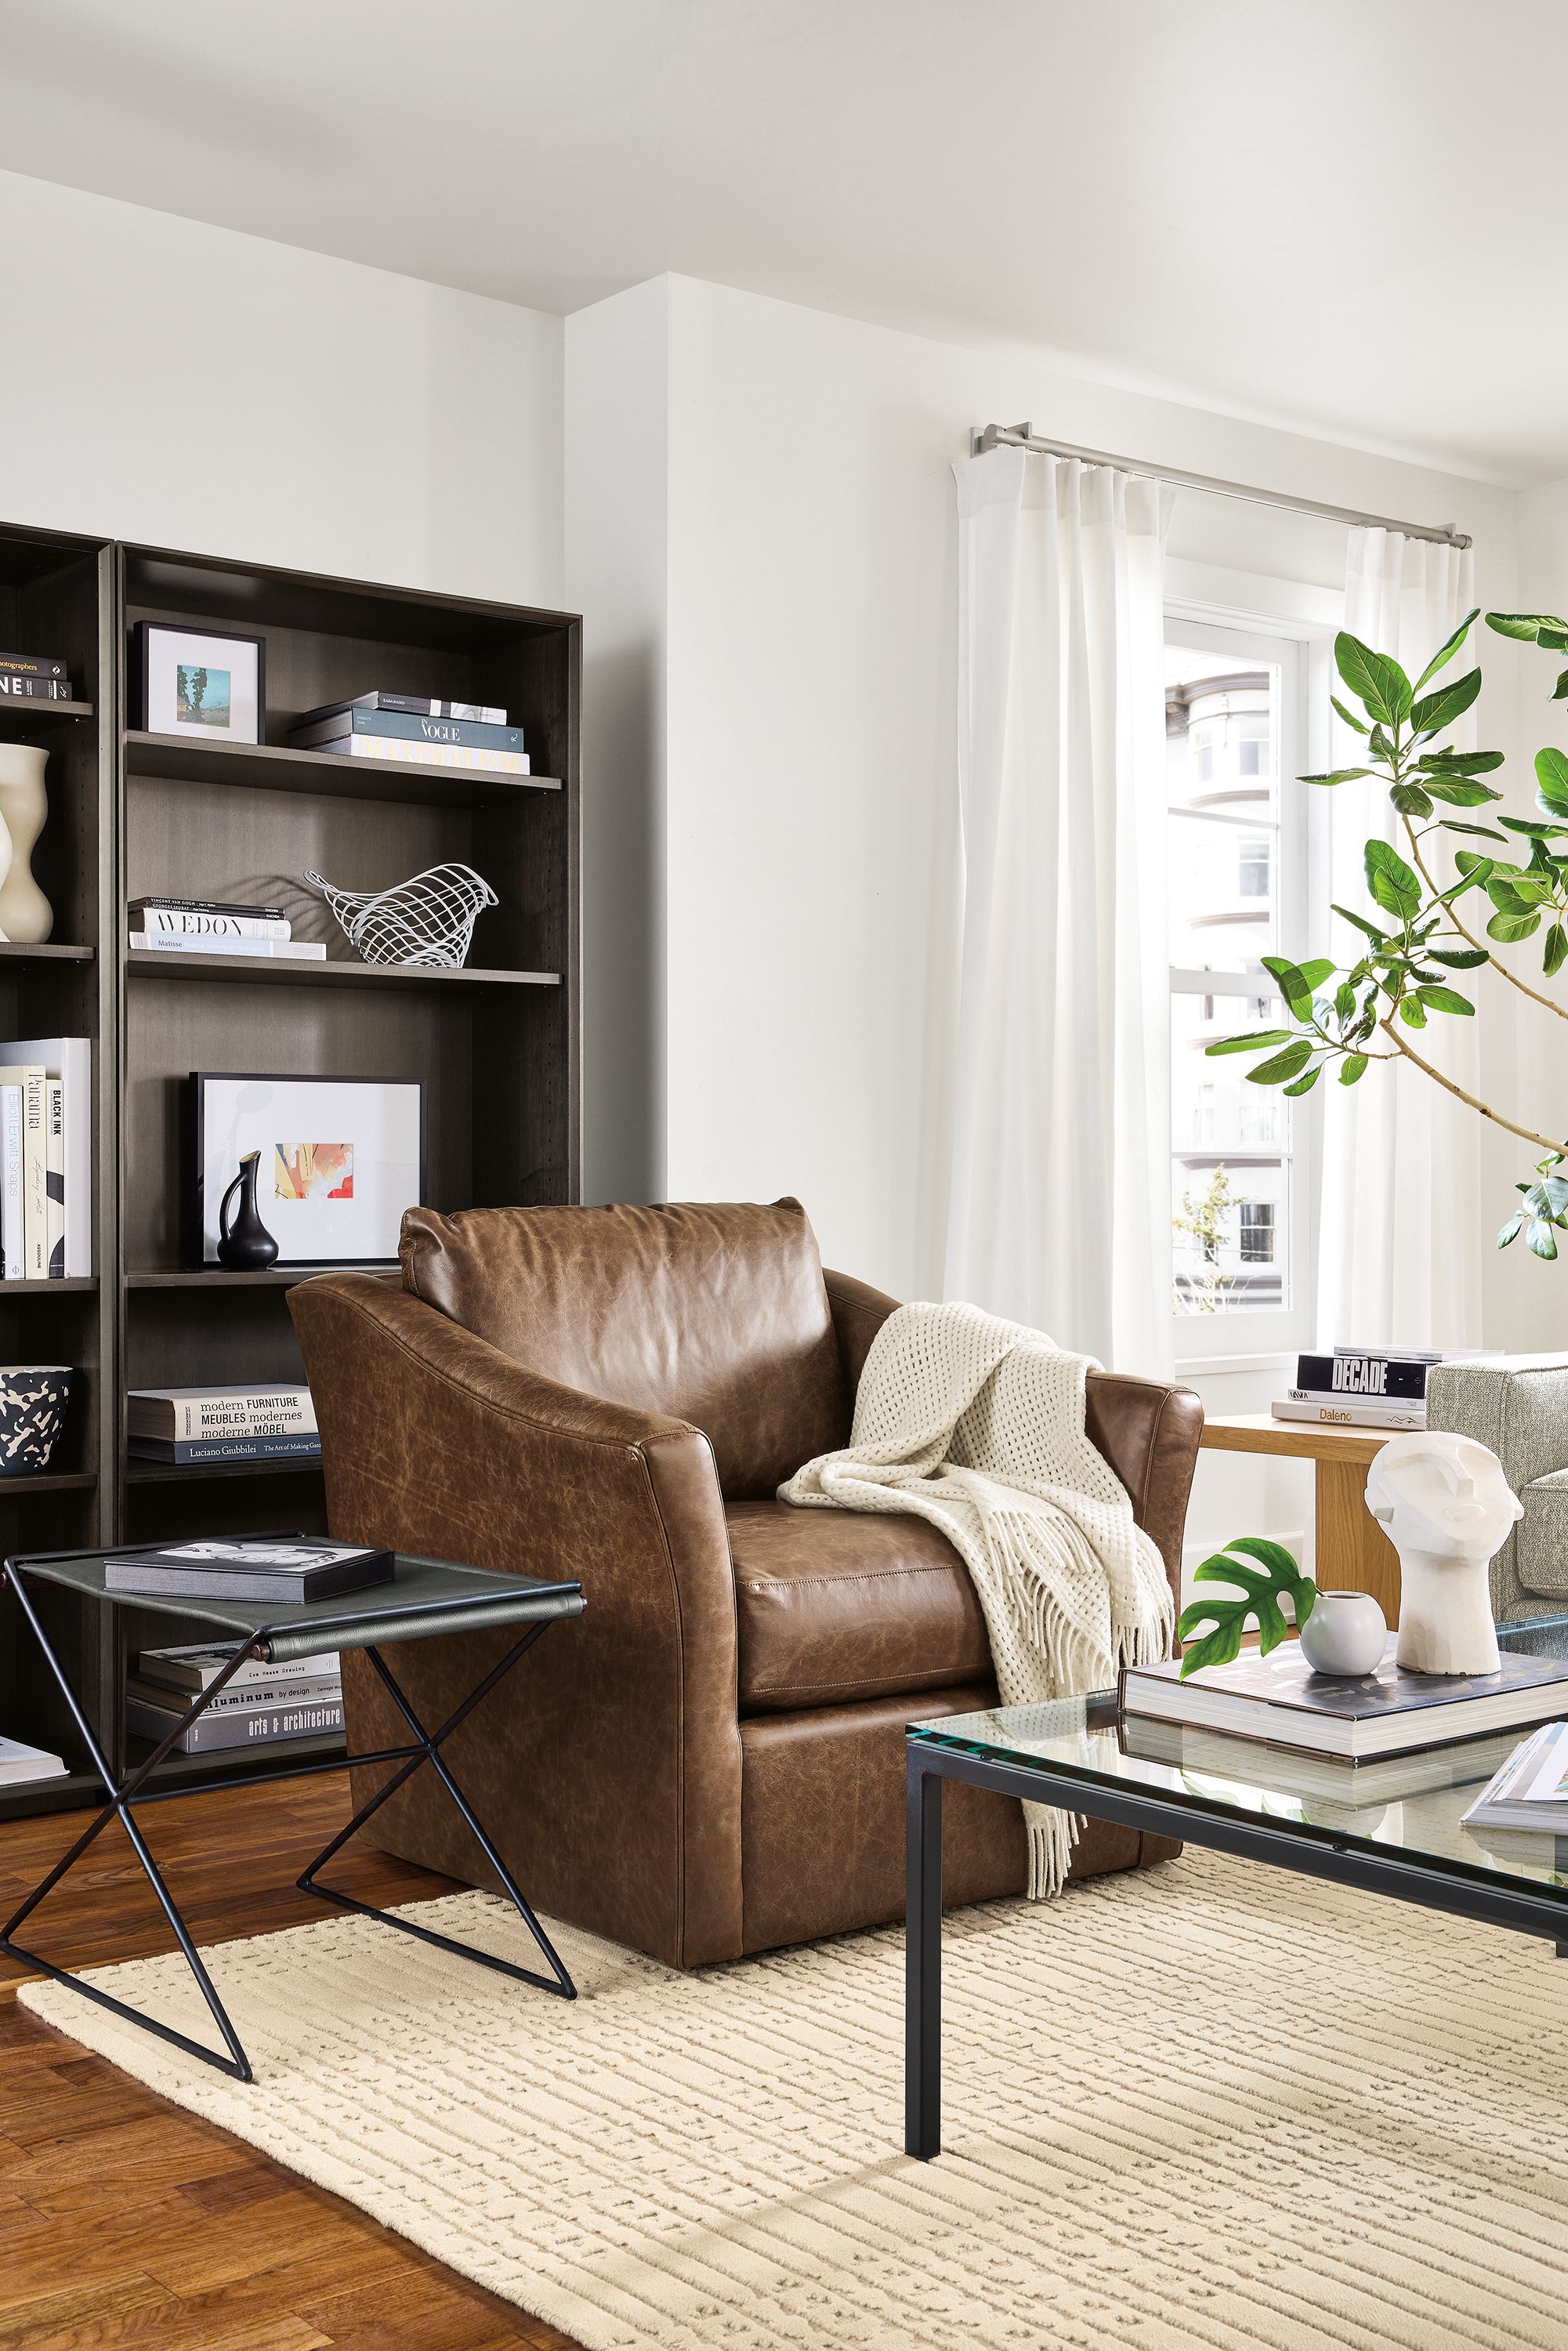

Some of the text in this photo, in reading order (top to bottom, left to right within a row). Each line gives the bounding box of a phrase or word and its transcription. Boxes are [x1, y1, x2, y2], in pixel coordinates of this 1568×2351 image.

[421, 724, 461, 741] VOGUE
[363, 736, 519, 773] MAXIMALISM
[28, 1074, 45, 1130] Panama
[53, 1089, 62, 1136] BLACK INK
[8, 1093, 20, 1197] Elliott Erwitt Snaps
[1331, 1358, 1389, 1394] DECADE
[201, 1396, 299, 1412] modern FURNITURE
[201, 1412, 246, 1425] MEUBLES
[249, 1411, 302, 1422] modernes
[201, 1422, 287, 1439] moderne MÖBEL
[190, 1447, 221, 1458] Luciano
[221, 1444, 257, 1455] Giubbilei
[278, 1690, 287, 1699] by
[288, 1688, 310, 1697] design
[248, 1708, 340, 1737] arts & architecture
